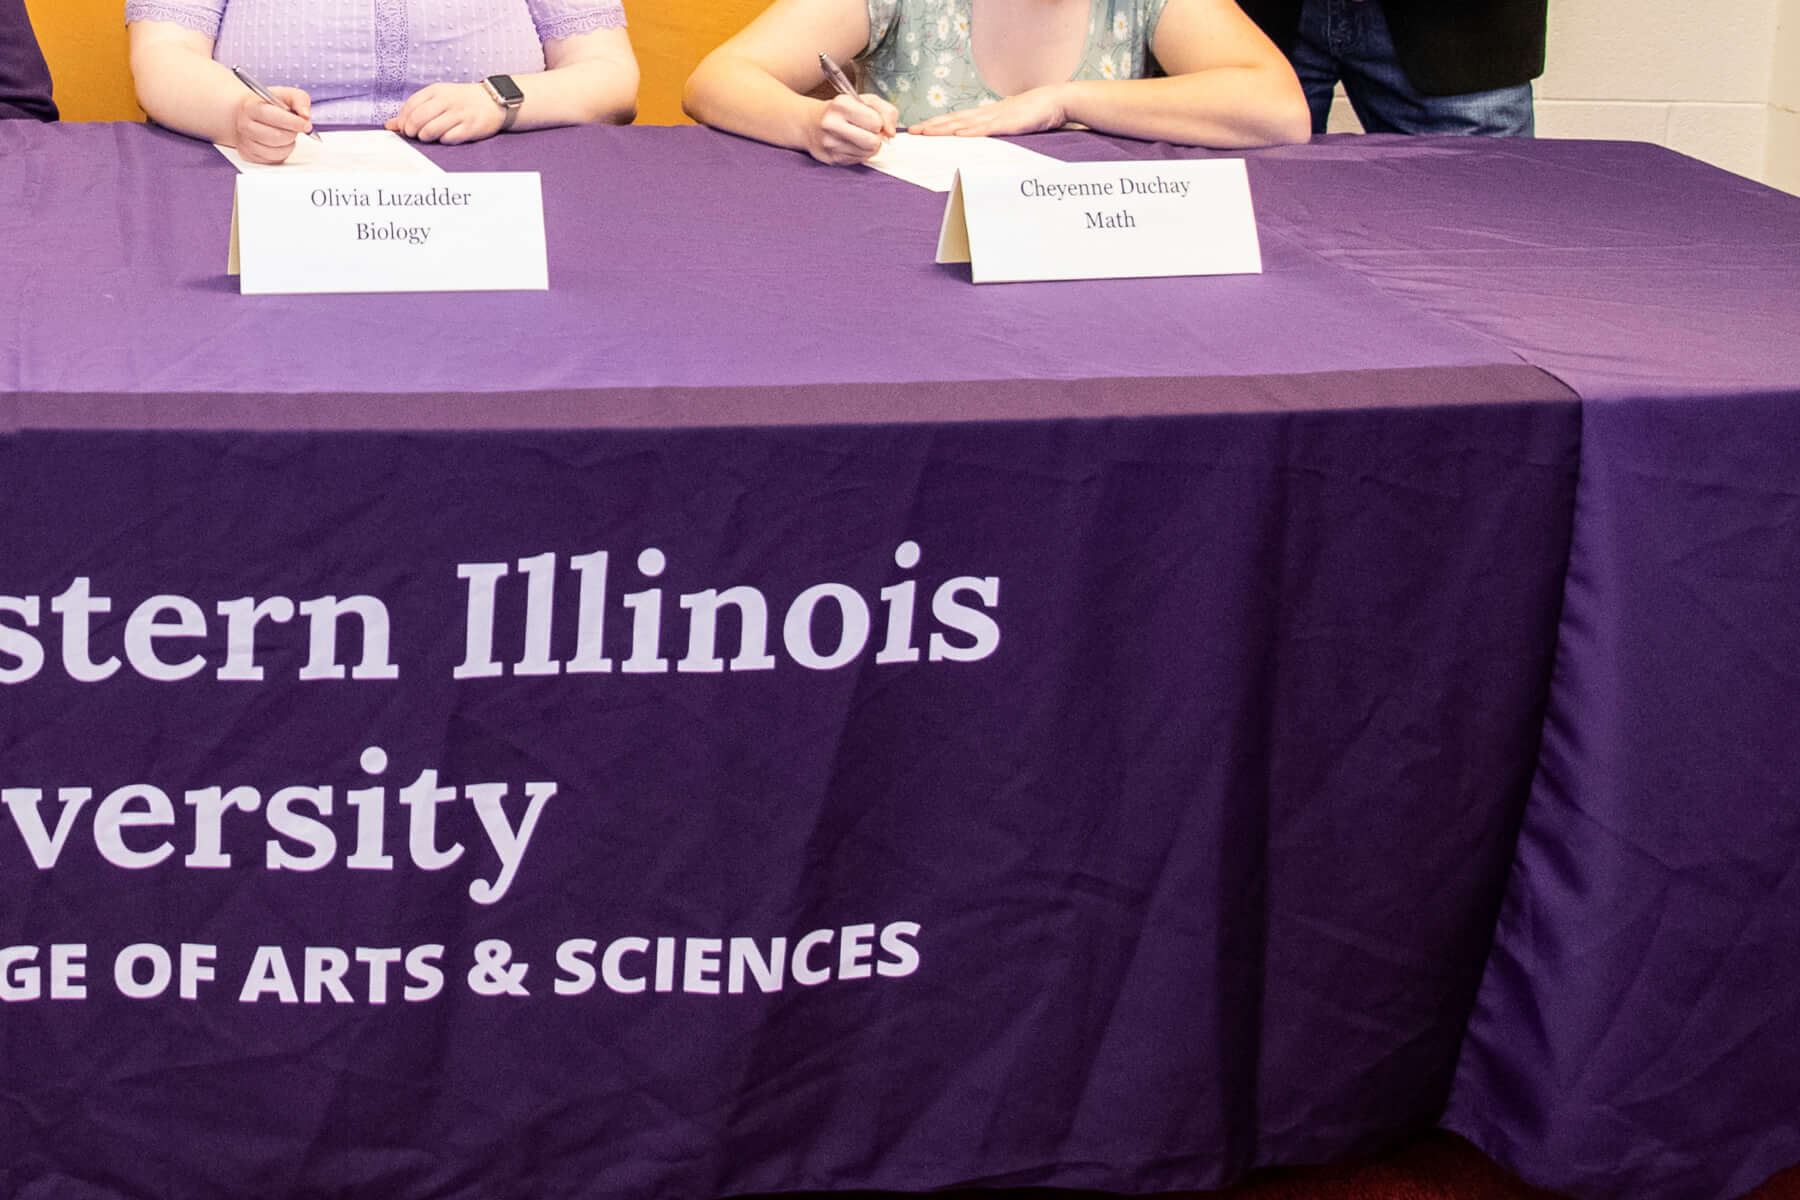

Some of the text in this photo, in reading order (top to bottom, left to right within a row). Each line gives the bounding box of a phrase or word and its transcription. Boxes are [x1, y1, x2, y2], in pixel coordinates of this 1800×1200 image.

[310, 187, 472, 207] Olivia Luzadder
[1020, 176, 1191, 201] Cheyenne Duchay
[1085, 209, 1137, 230] Math
[356, 221, 432, 245] Biology
[453, 540, 1002, 680] Illinois
[114, 942, 217, 1000] OF
[238, 943, 445, 1004] ARTS
[467, 939, 530, 996] &
[554, 921, 921, 996] SCIENCES
